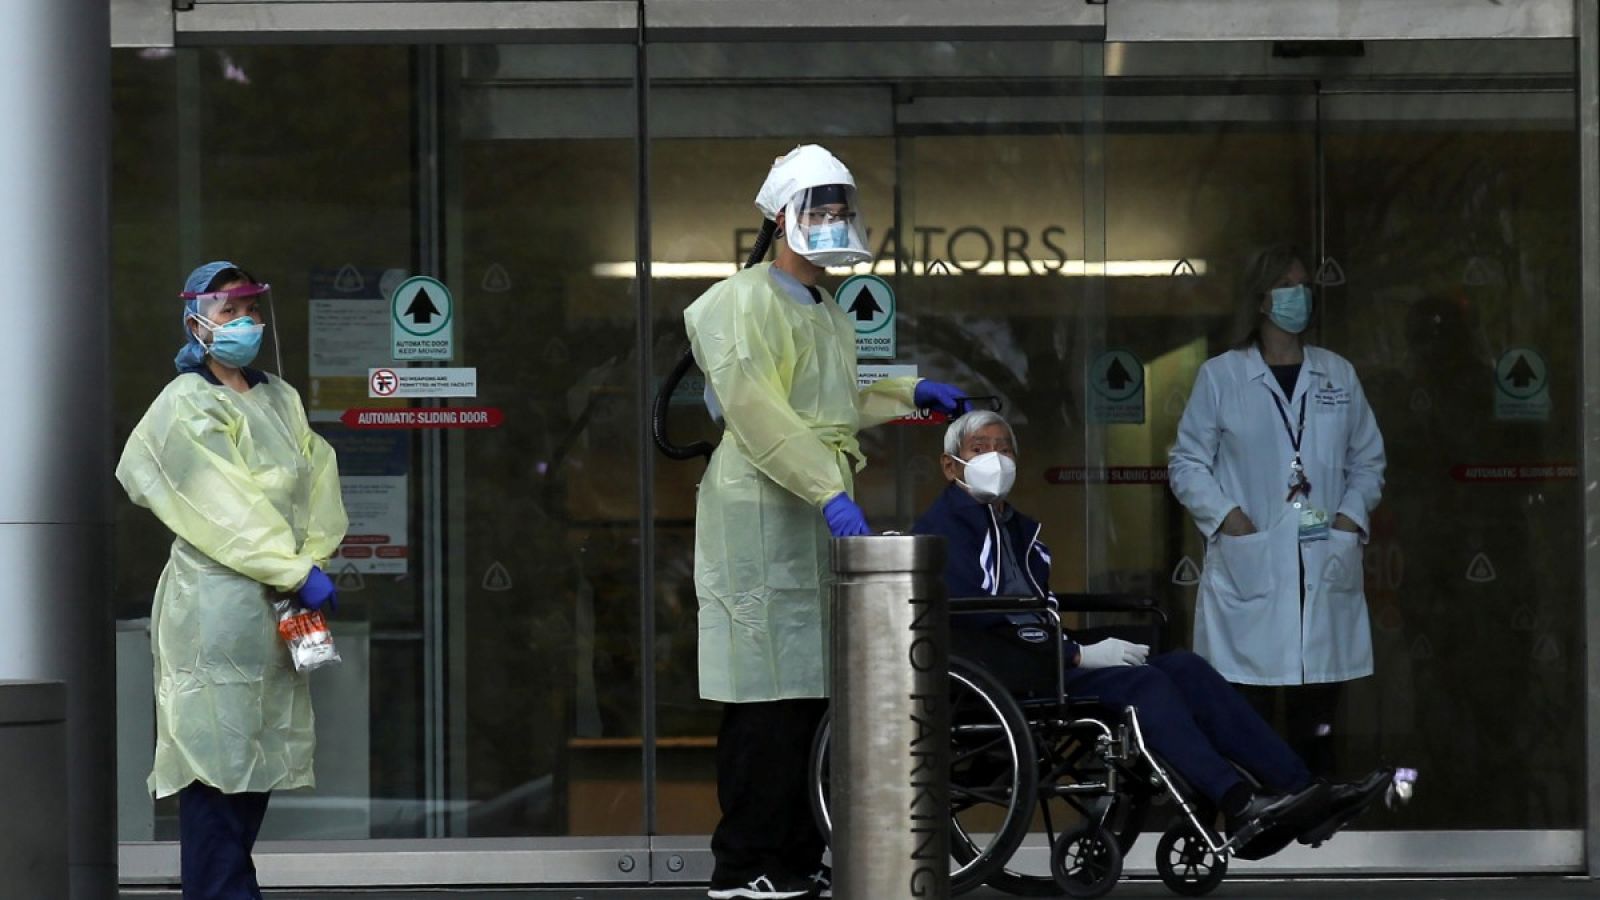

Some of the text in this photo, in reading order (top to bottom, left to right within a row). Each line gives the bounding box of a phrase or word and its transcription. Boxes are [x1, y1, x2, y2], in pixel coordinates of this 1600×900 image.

[733, 226, 1067, 275] EATORS
[358, 412, 488, 425] AUTOMATIC SLIDING DOOR
[908, 598, 938, 897] NO PARKING
